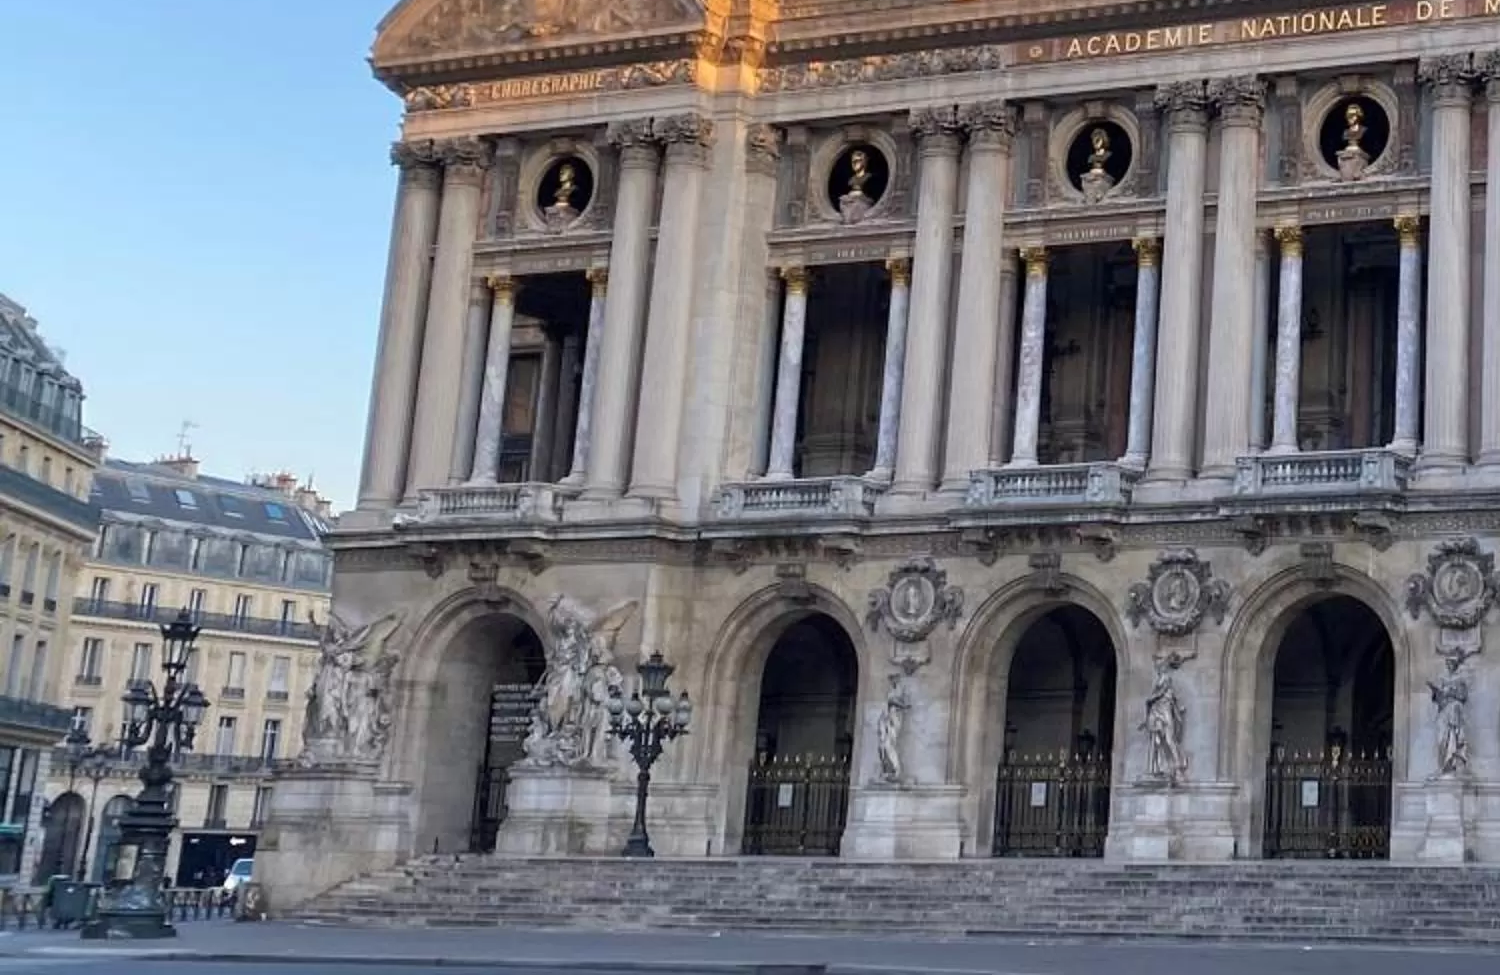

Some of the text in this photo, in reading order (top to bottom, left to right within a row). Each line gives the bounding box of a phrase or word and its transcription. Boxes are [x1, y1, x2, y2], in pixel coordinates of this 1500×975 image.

[1067, 24, 1213, 58] ACADEMIE
[1240, 4, 1388, 39] NATIONALE
[491, 73, 603, 99] CHOREGRAPHIE
